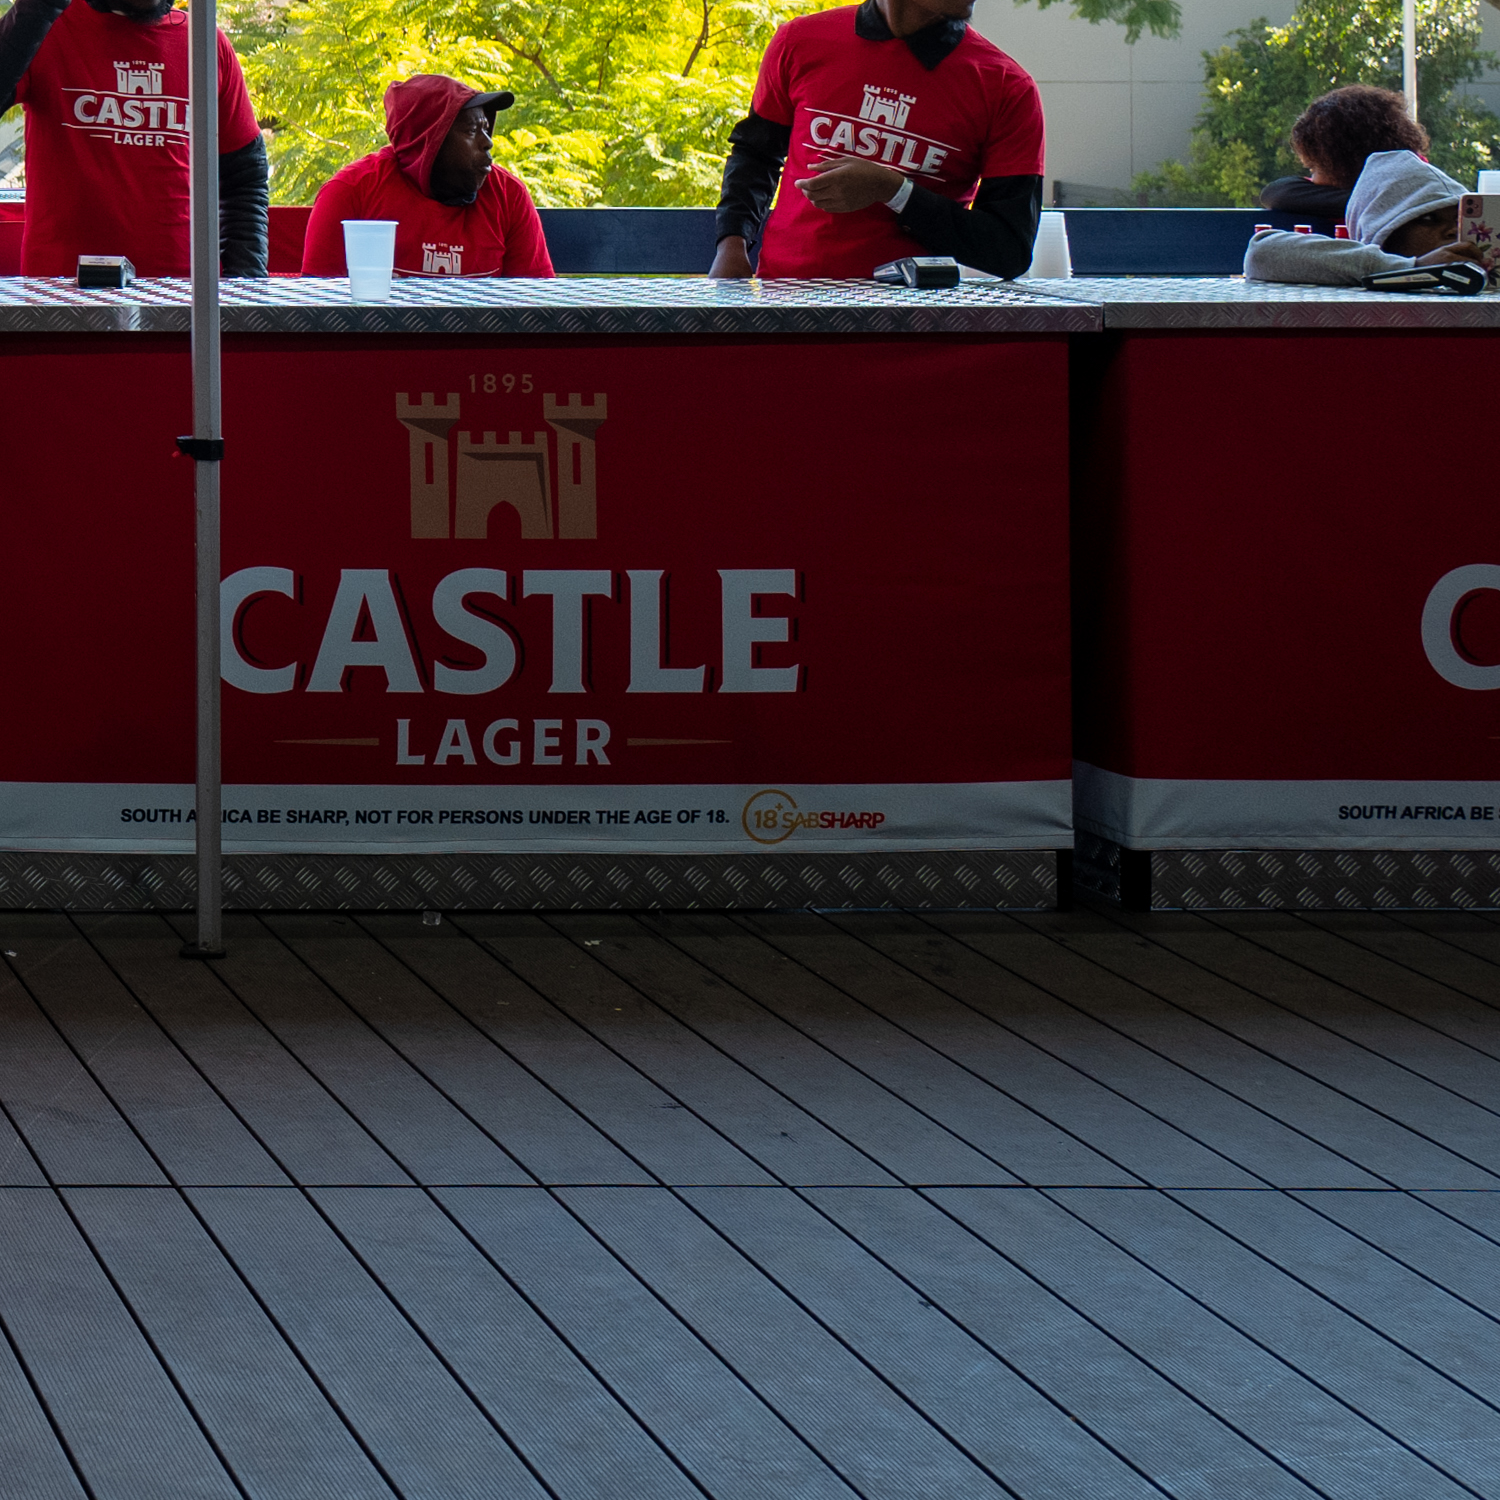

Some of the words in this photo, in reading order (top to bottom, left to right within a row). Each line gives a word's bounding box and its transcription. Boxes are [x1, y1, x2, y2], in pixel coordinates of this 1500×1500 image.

[114, 132, 165, 146] LAGER
[810, 116, 948, 173] CASTLE
[468, 373, 535, 393] 1895
[220, 566, 800, 695] CASTLE
[395, 718, 611, 766] LAGER
[120, 808, 182, 823] SOUTH
[185, 809, 254, 823] AICA
[257, 810, 282, 824] BE
[286, 809, 350, 827] SHARP,
[355, 810, 393, 824] NOT
[397, 810, 434, 824] FOR
[439, 810, 524, 825] PERSONS
[529, 810, 591, 825] UNDER
[595, 810, 630, 825] THE
[634, 810, 672, 825] AGE
[677, 810, 701, 824] OF
[706, 809, 730, 824] 18.
[1338, 806, 1397, 820] SOUTH
[1400, 806, 1466, 820] AFRICA
[1470, 806, 1494, 820] BE
